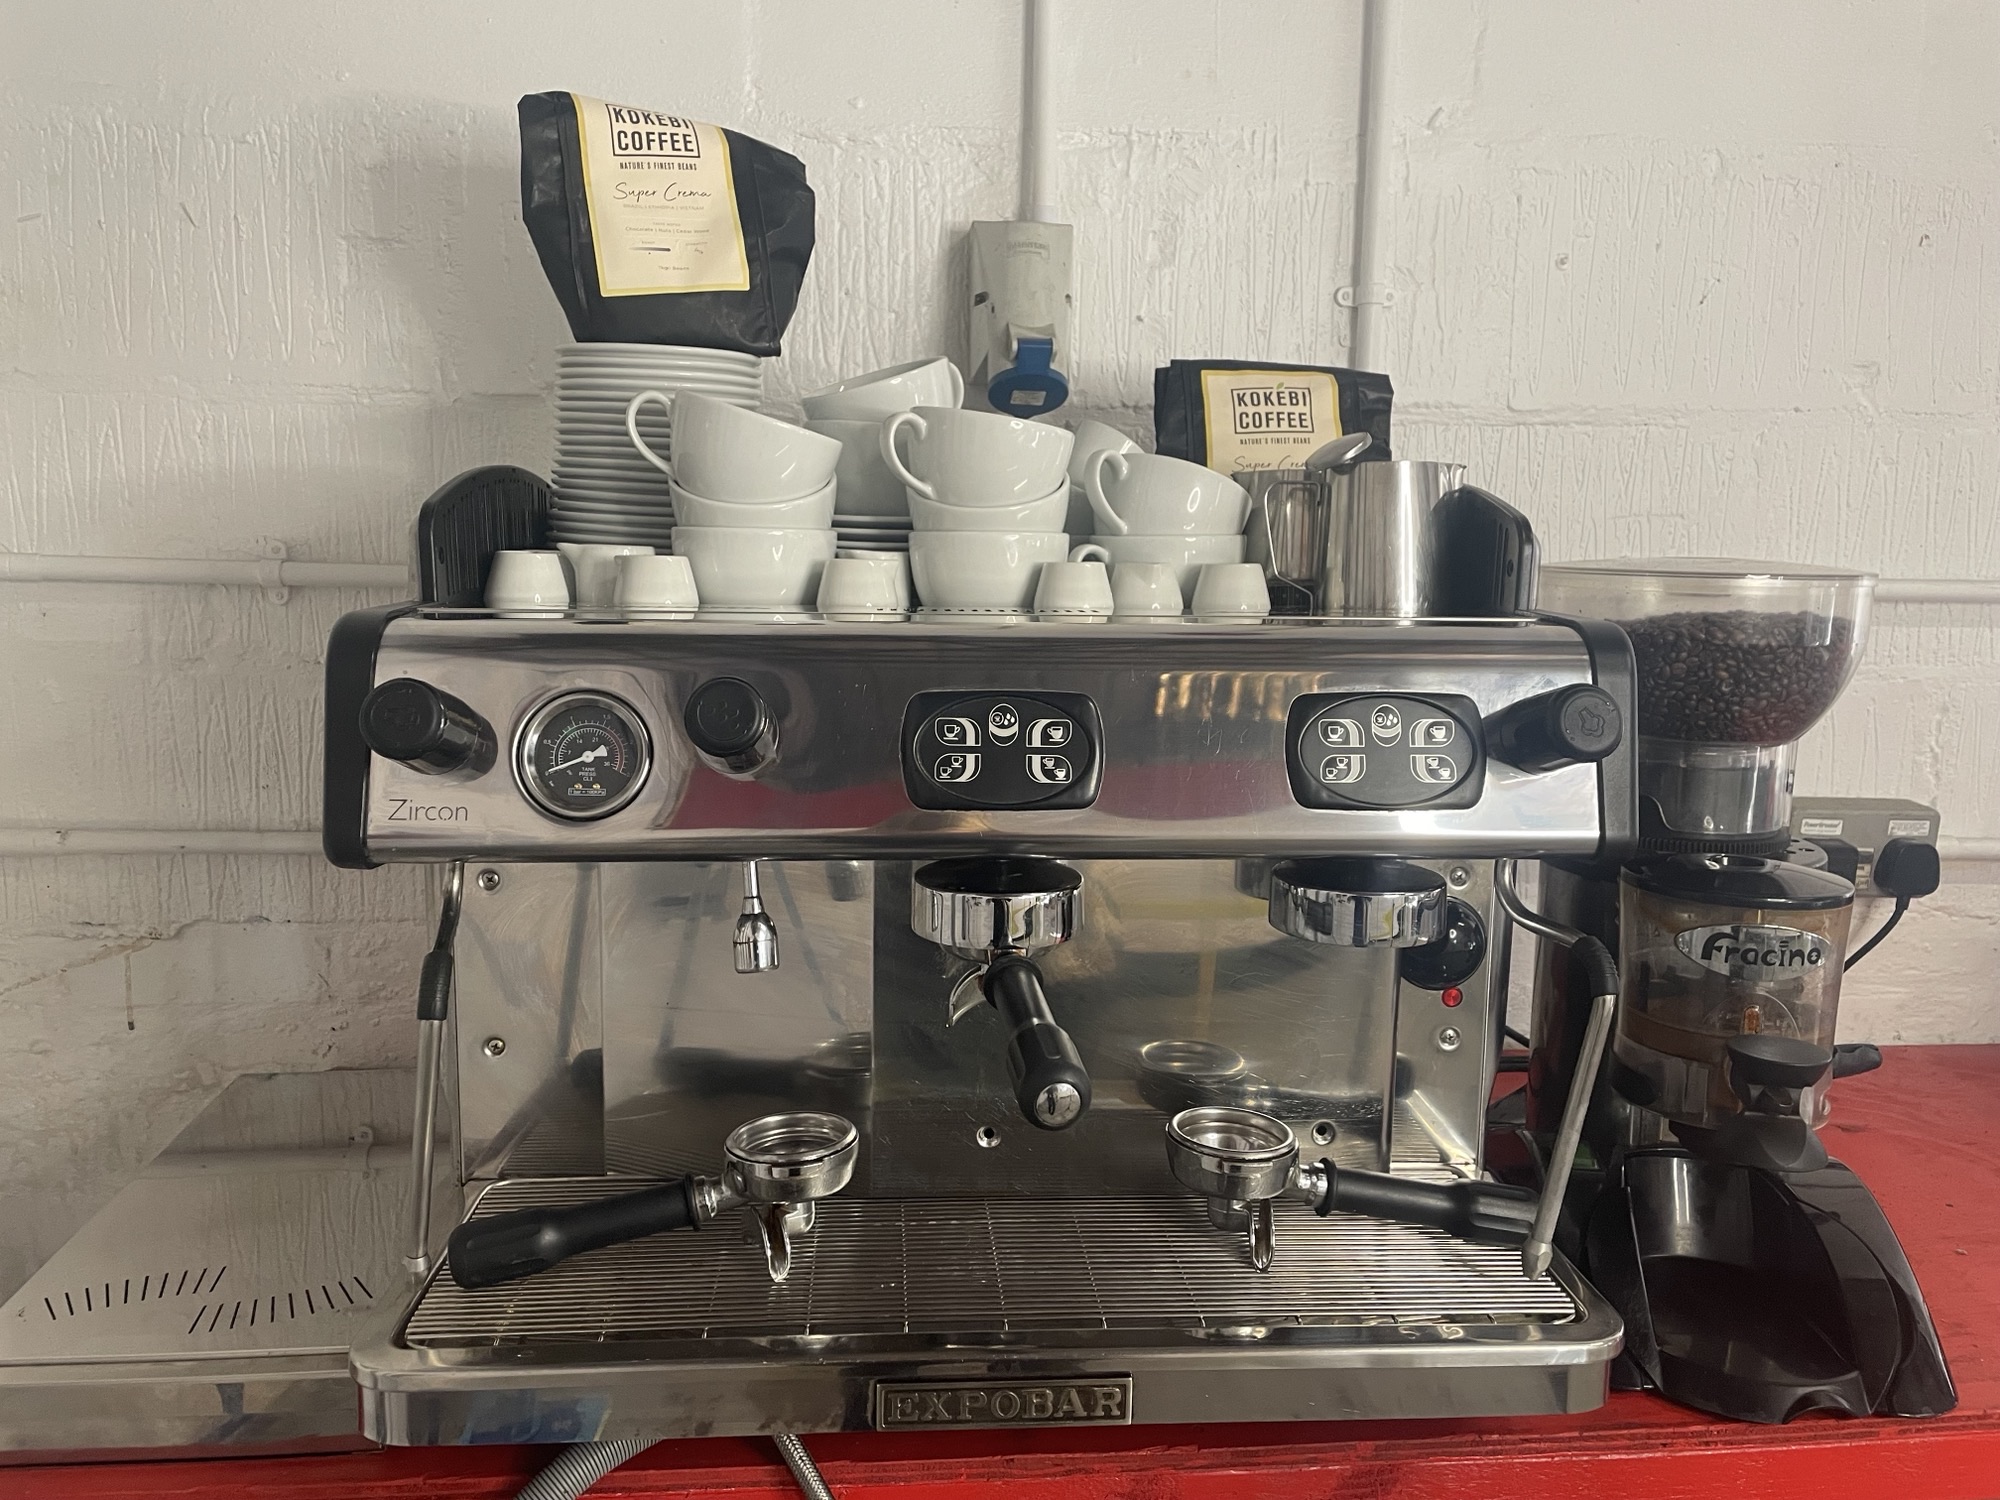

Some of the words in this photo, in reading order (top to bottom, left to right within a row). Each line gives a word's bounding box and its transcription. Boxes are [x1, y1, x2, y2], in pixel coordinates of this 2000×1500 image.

[612, 107, 689, 129] KOKEBI
[617, 130, 694, 152] COFFEE
[619, 161, 651, 170] NATURE'S
[653, 162, 675, 170] FINEST
[678, 162, 697, 171] BEANS
[613, 182, 657, 203] Super
[663, 182, 712, 202] Crema
[1236, 391, 1307, 407] KOKEBI
[1239, 411, 1309, 429] COFFEE
[1239, 437, 1268, 445] NATURE'S
[1270, 437, 1290, 445] FINEST
[1293, 437, 1311, 445] BEANS
[1231, 455, 1272, 473] Super
[1277, 454, 1306, 471] Cre
[387, 798, 468, 821] Zircon
[1700, 931, 1822, 967] Fracino
[887, 1387, 1124, 1422] EXPOBAR
